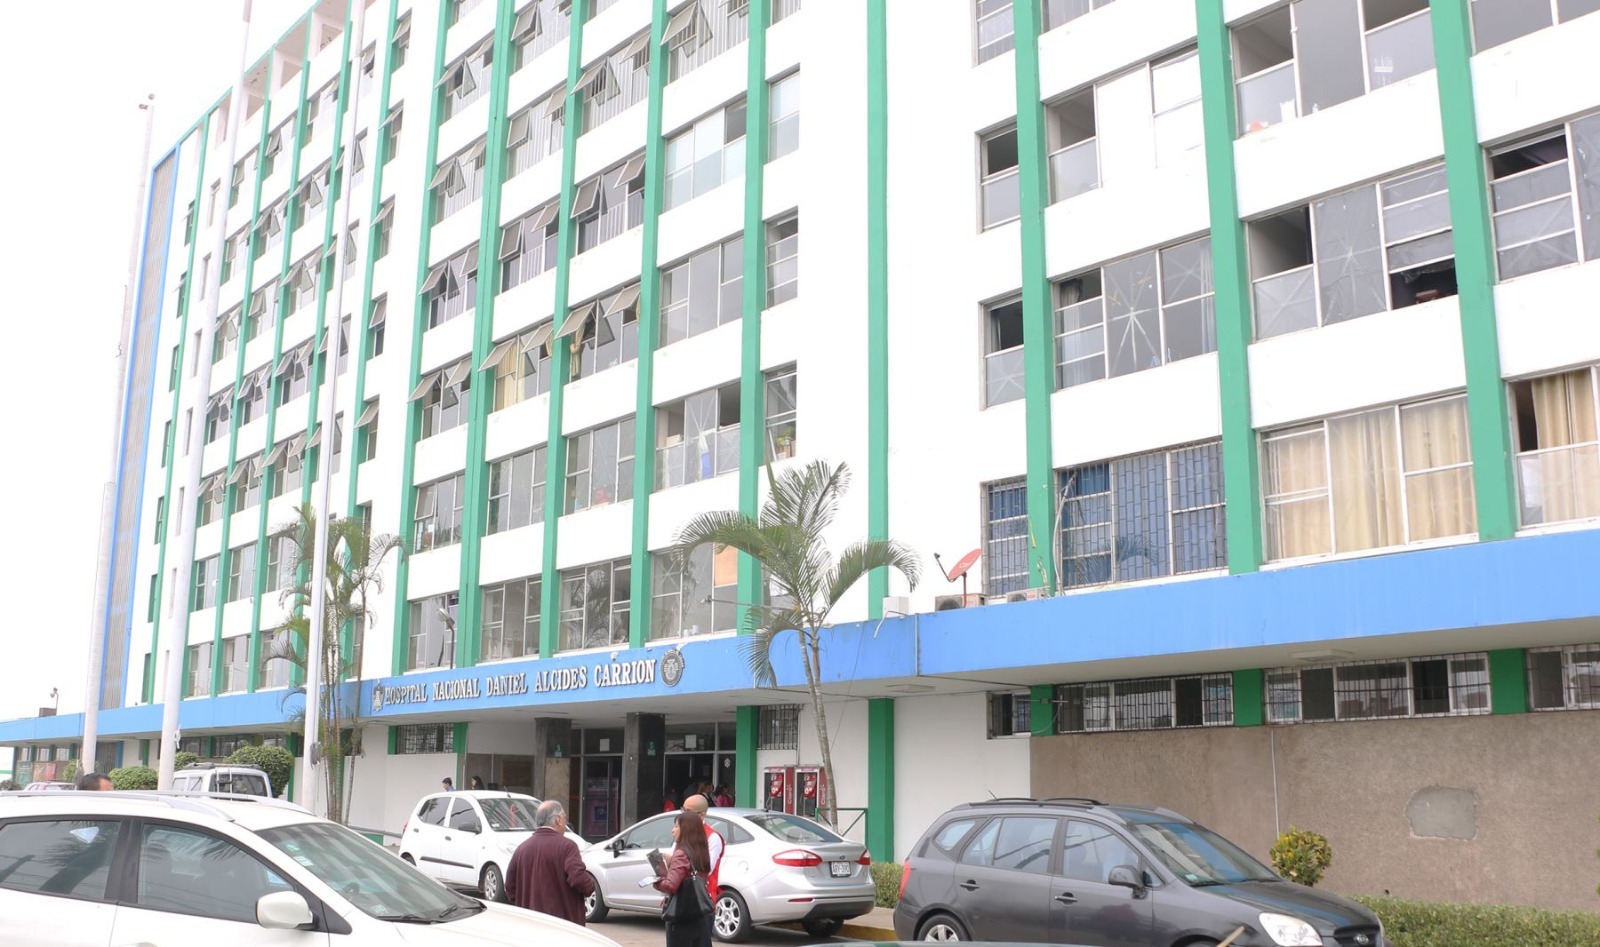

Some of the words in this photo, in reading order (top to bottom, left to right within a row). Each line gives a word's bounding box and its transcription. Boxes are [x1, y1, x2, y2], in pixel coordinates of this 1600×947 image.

[384, 684, 427, 705] HOSPITAL
[432, 678, 480, 700] NACIONAL
[486, 673, 527, 696] DANIEL
[535, 667, 587, 693] ALCIDES
[594, 660, 656, 687] CARRION
